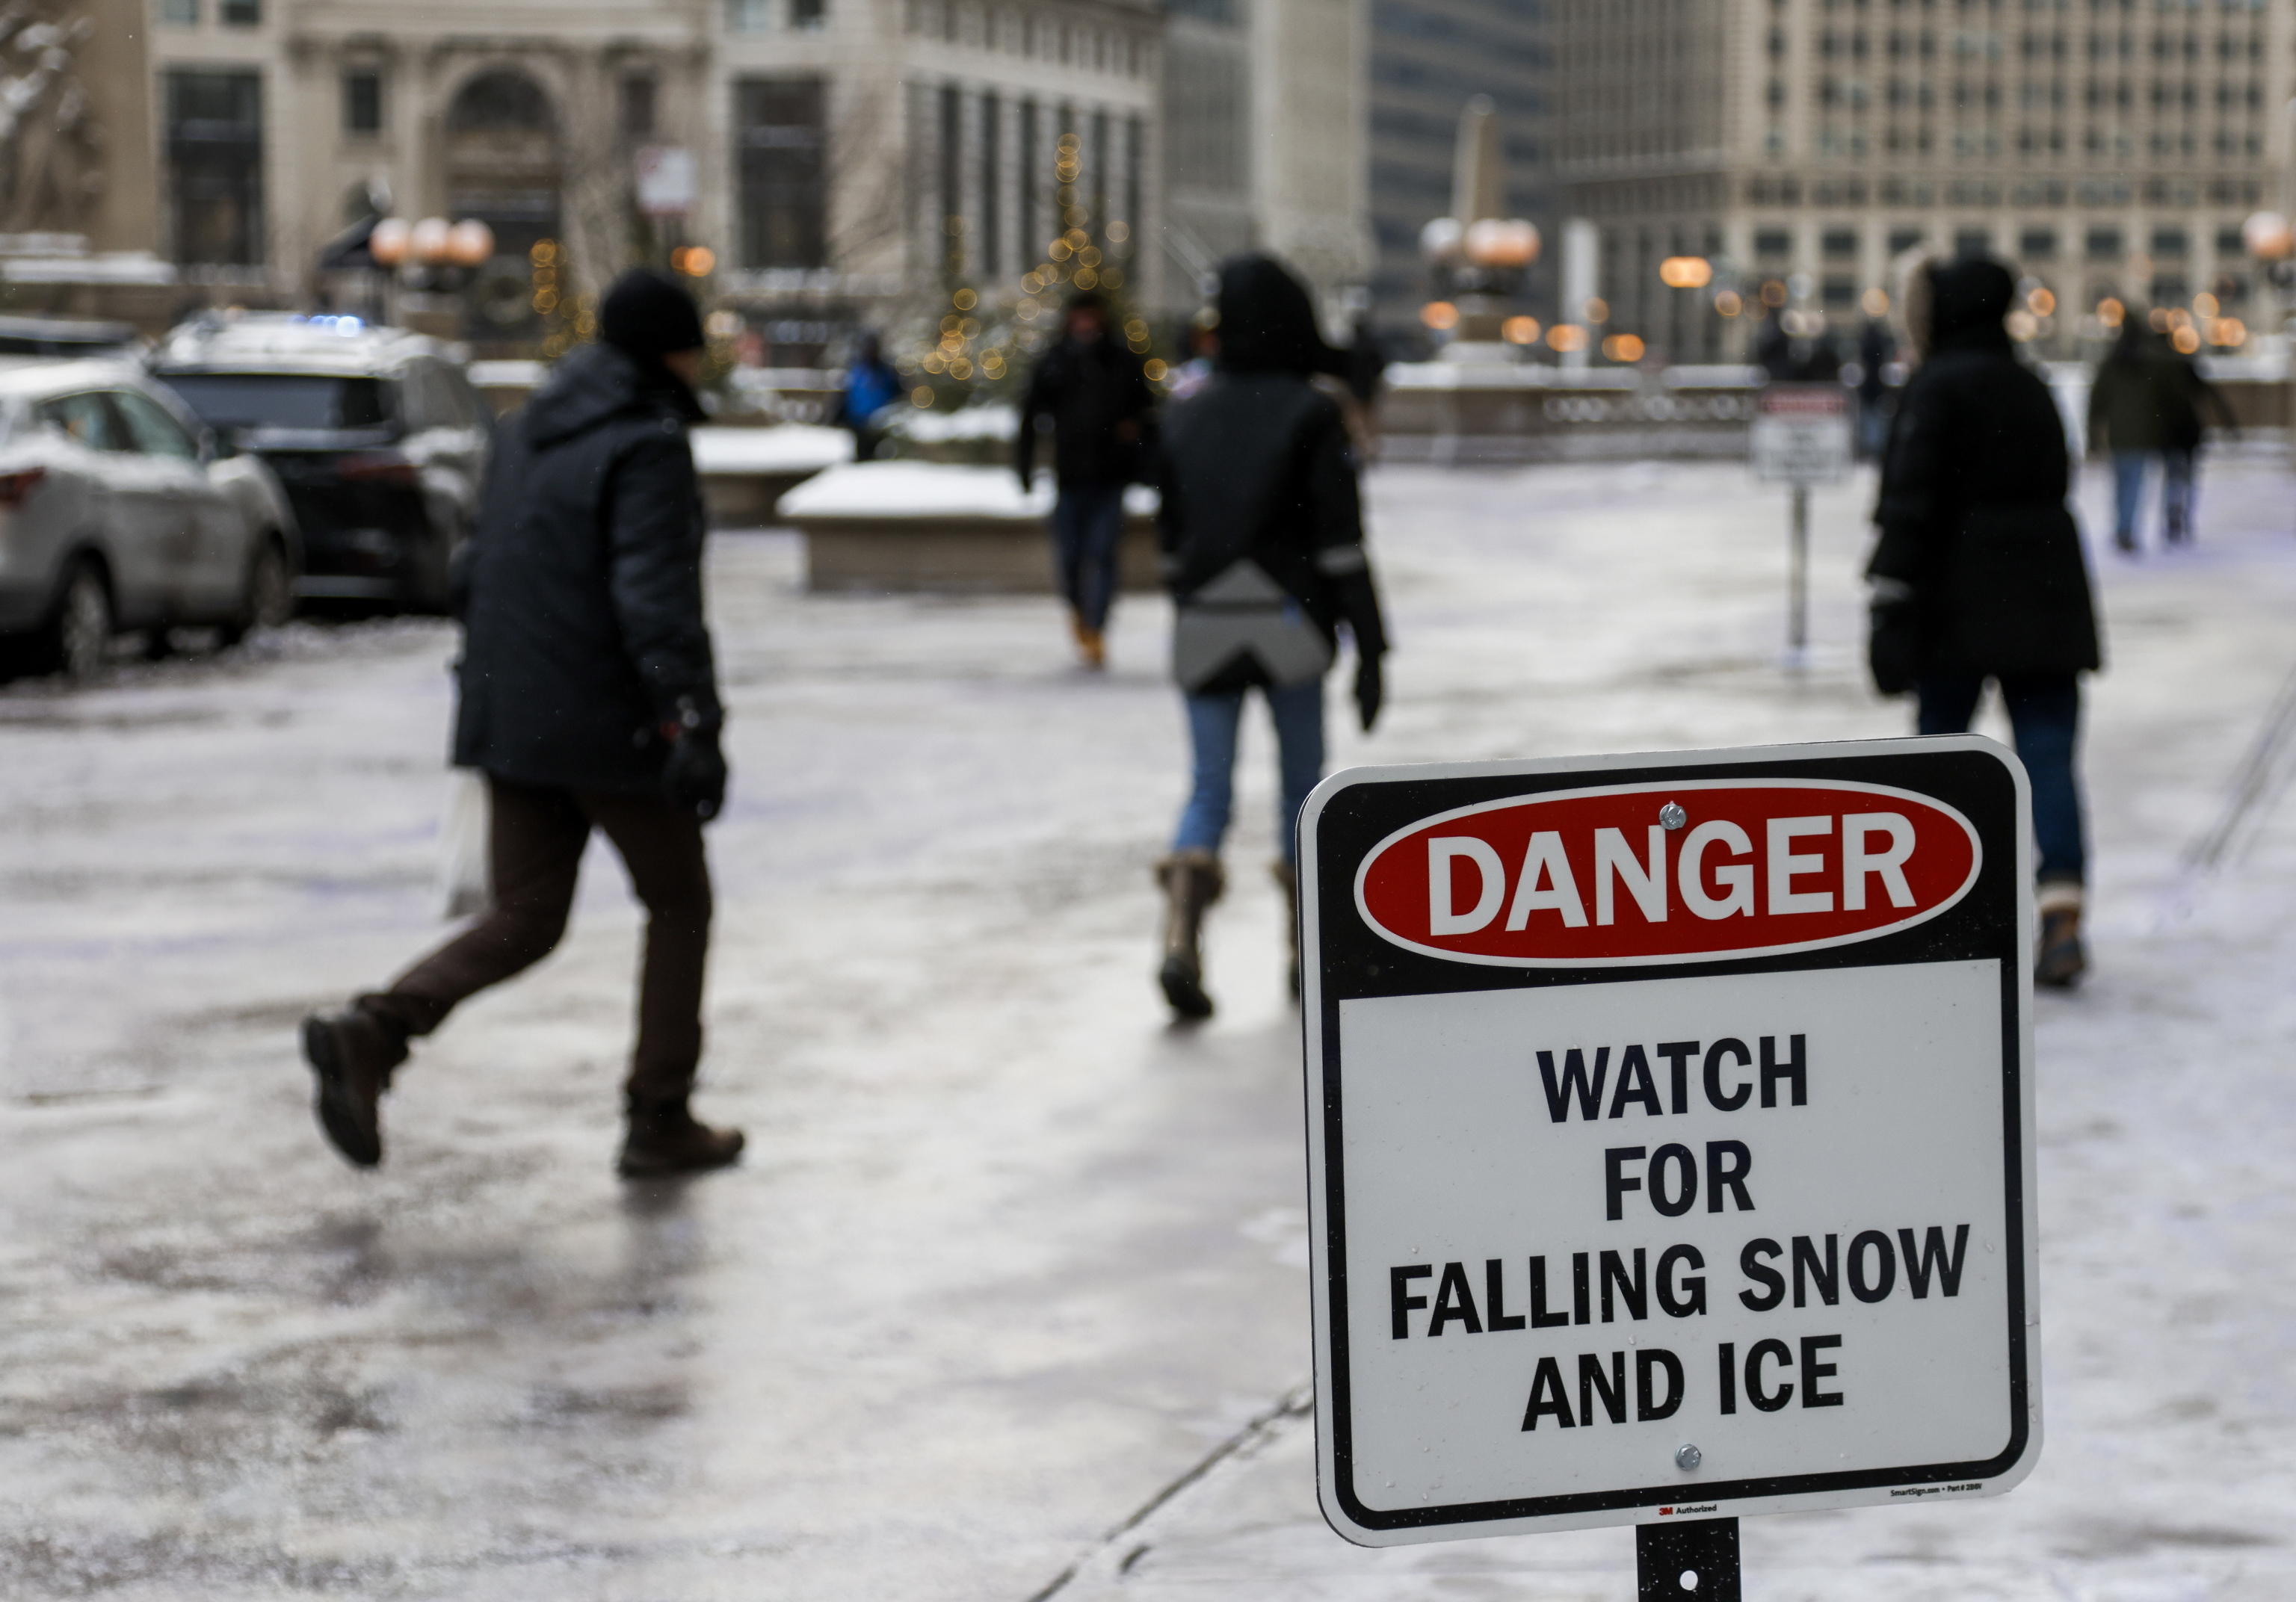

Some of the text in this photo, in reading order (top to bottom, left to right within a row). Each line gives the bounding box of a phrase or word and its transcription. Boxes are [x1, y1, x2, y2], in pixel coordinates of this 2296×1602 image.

[1428, 813, 1916, 935] DANGER
[1536, 1034, 1806, 1123] WATCH
[1605, 1140, 1755, 1221] FOR
[1391, 1224, 1969, 1340] FALLING SNOW
[1522, 1335, 1843, 1432] AND ICE
[1658, 1504, 1717, 1515] 3M Authorized
[1890, 1487, 1939, 1497] SmartSign.com
